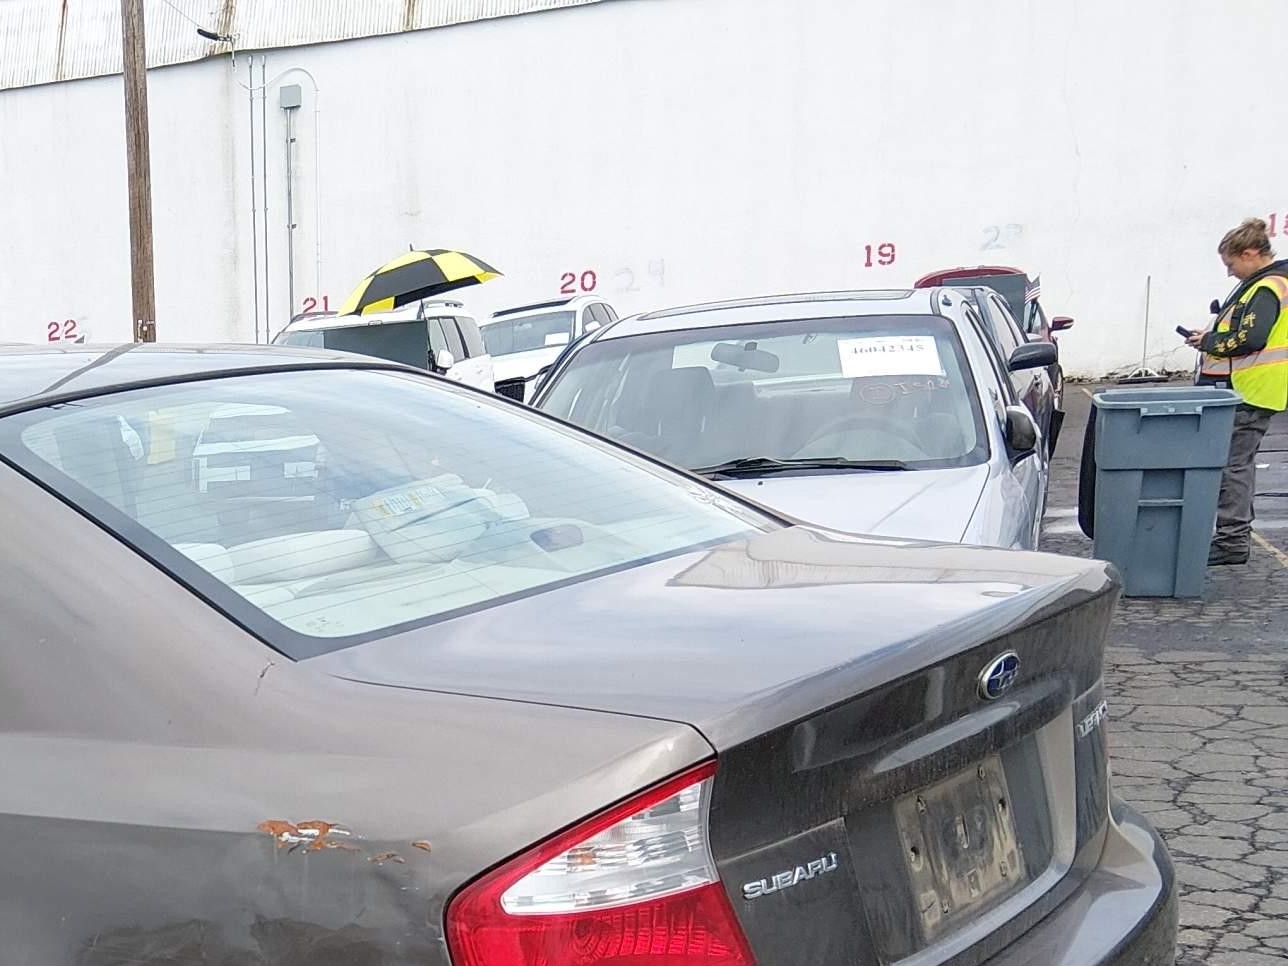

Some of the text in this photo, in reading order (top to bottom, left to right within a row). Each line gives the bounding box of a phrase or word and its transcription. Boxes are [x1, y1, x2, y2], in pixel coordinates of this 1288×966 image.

[865, 243, 896, 267] 19
[560, 270, 597, 294] 20
[303, 295, 329, 314] 21
[47, 320, 78, 342] 22
[742, 851, 838, 900] SUBARU
